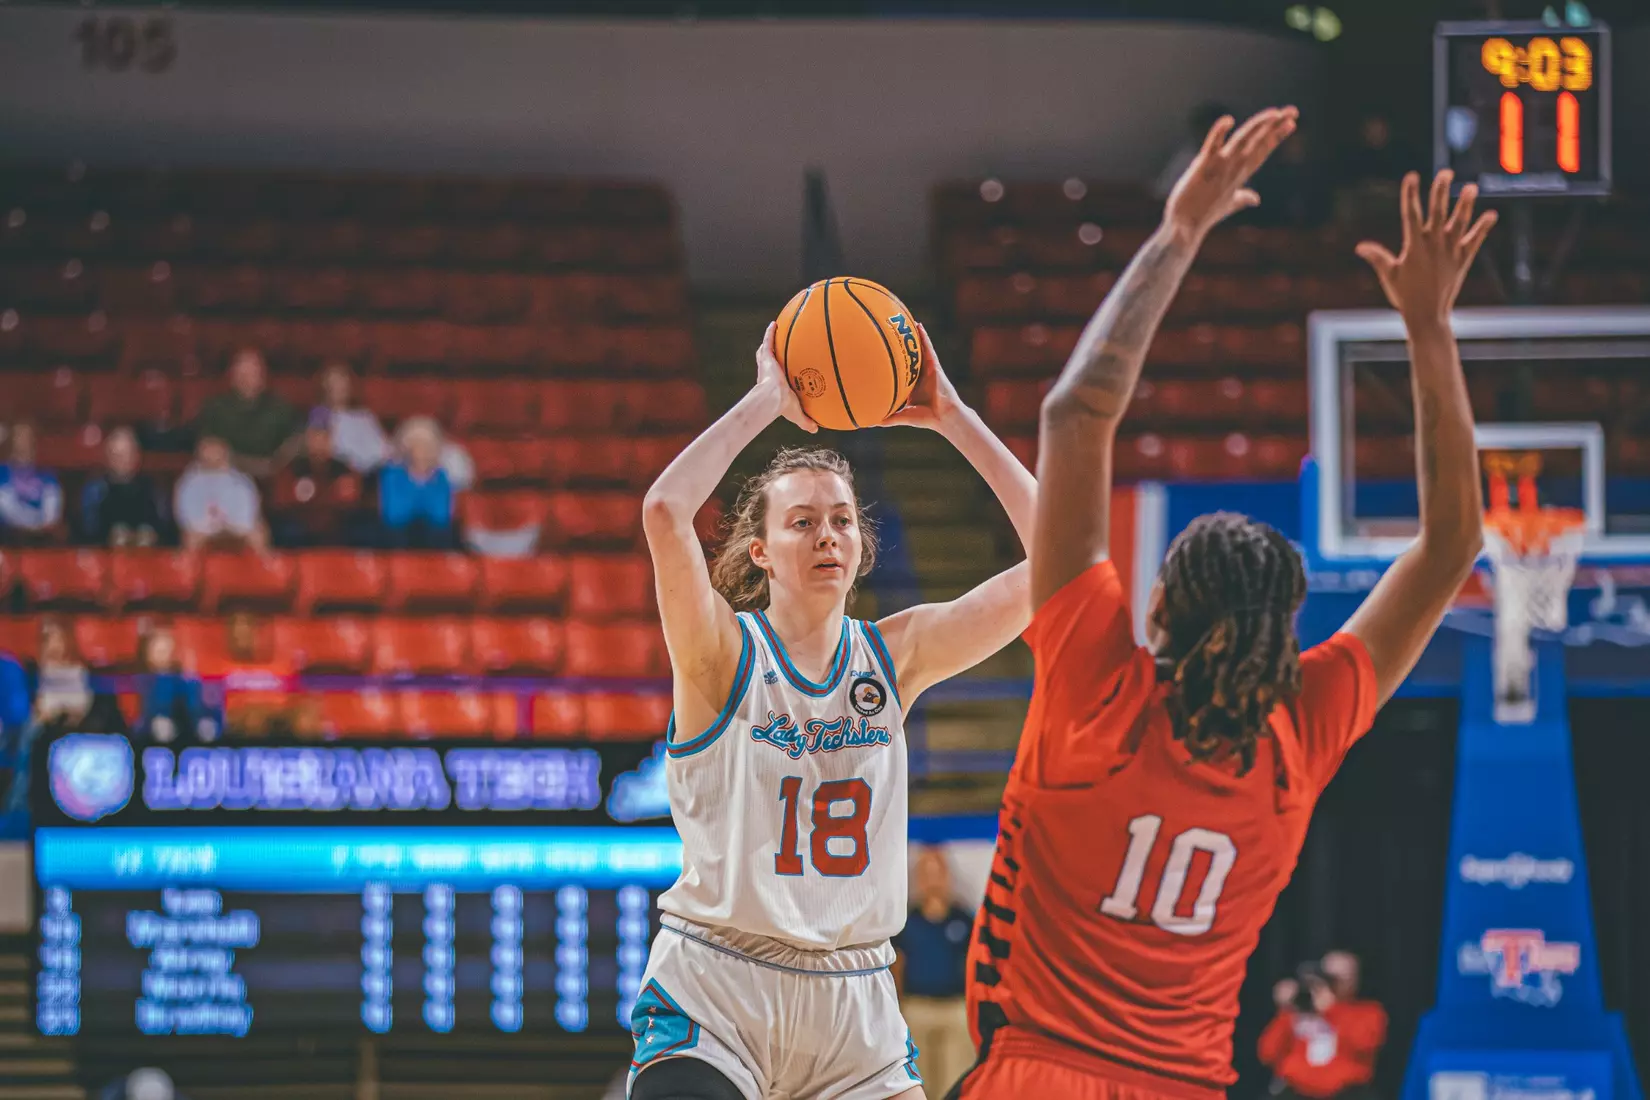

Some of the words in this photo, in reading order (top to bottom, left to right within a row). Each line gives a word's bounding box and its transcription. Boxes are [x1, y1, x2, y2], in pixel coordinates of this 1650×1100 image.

[1481, 37, 1593, 91] 9:03
[1499, 91, 1580, 174] 11
[888, 312, 919, 387] NCAA
[750, 710, 807, 760] Lady
[804, 715, 892, 755] Techsters
[774, 775, 873, 877] 18
[1100, 813, 1238, 937] 10
